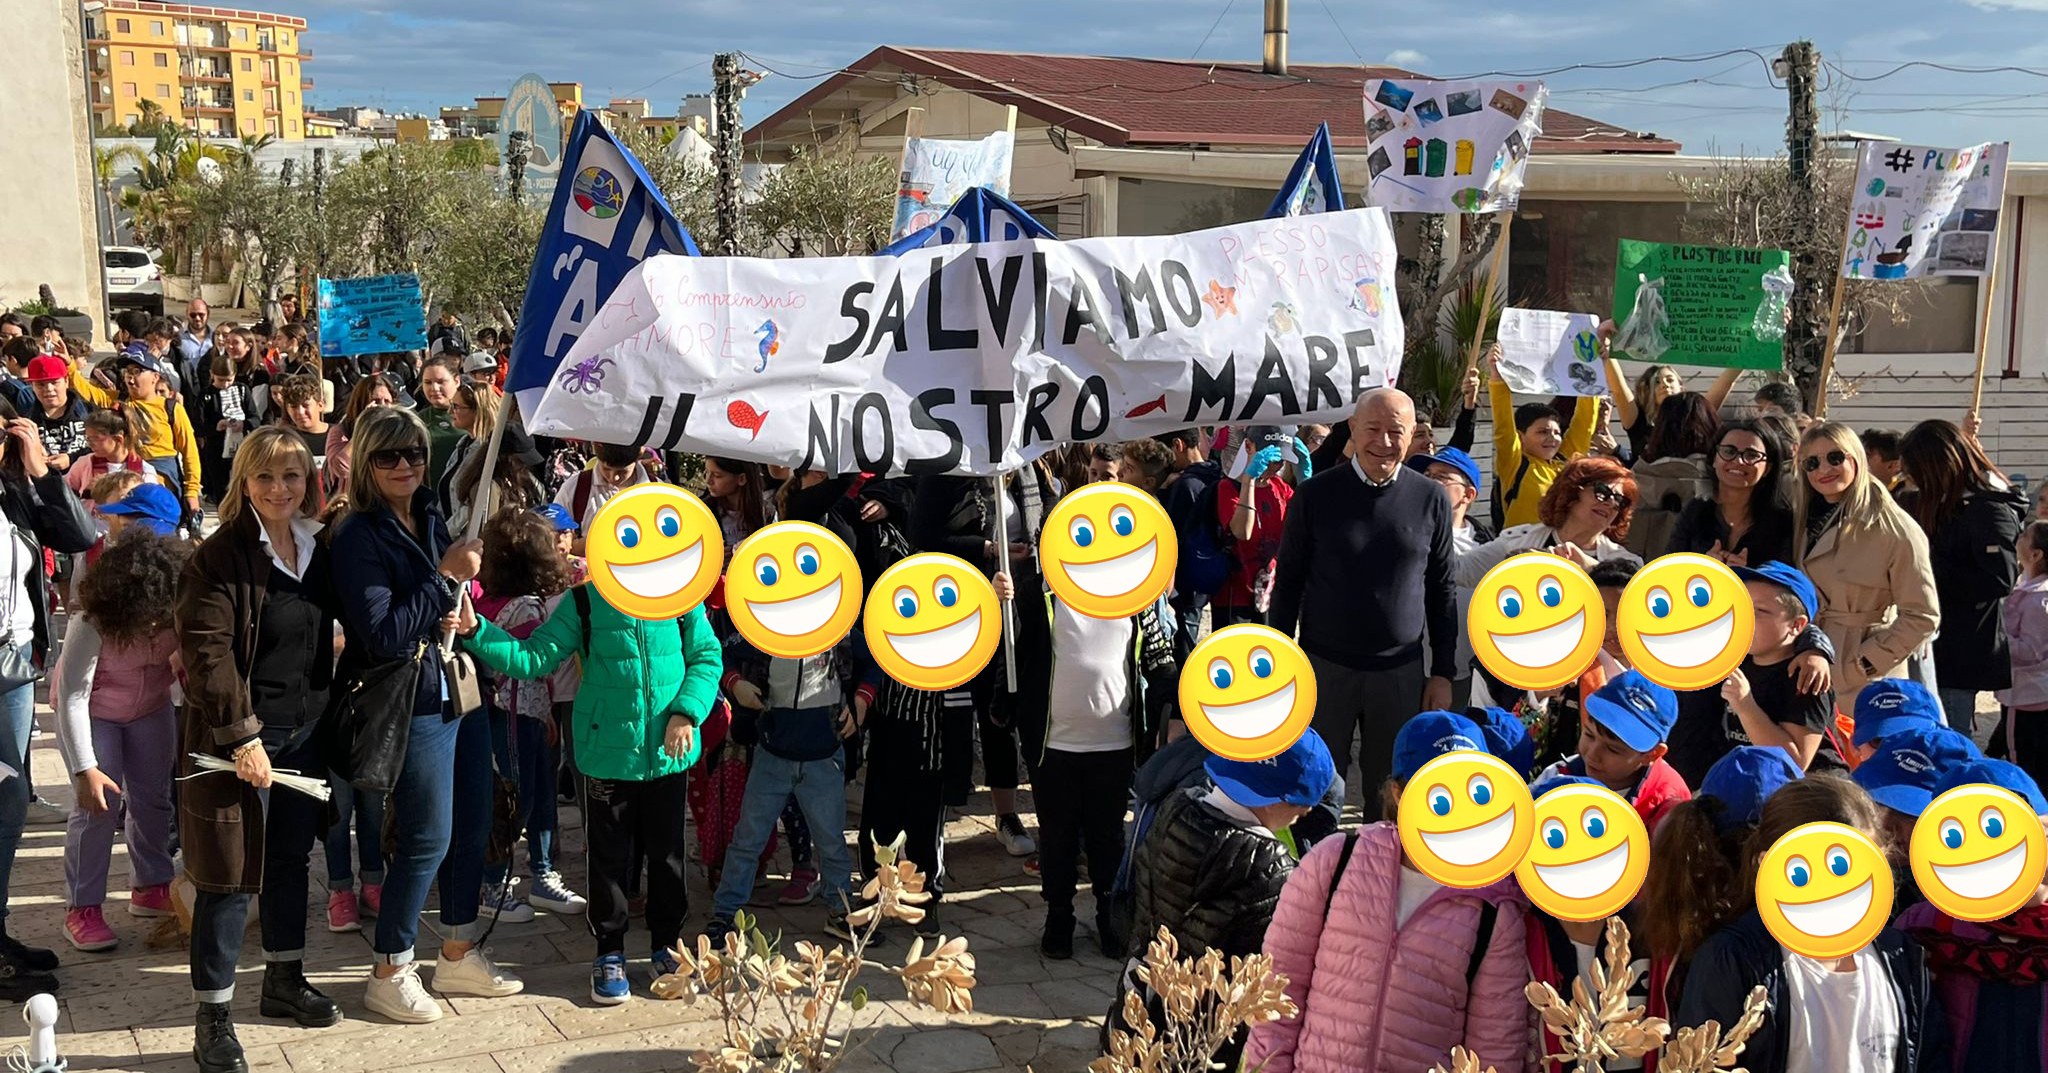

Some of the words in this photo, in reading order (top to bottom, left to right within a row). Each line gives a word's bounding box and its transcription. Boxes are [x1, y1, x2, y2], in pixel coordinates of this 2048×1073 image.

[1219, 224, 1328, 264] PLESSO
[823, 252, 1202, 363] SALVIAMO
[793, 375, 1110, 479] NOSTRO
[1183, 328, 1385, 421] MARE
[1264, 433, 1293, 445] adidas
